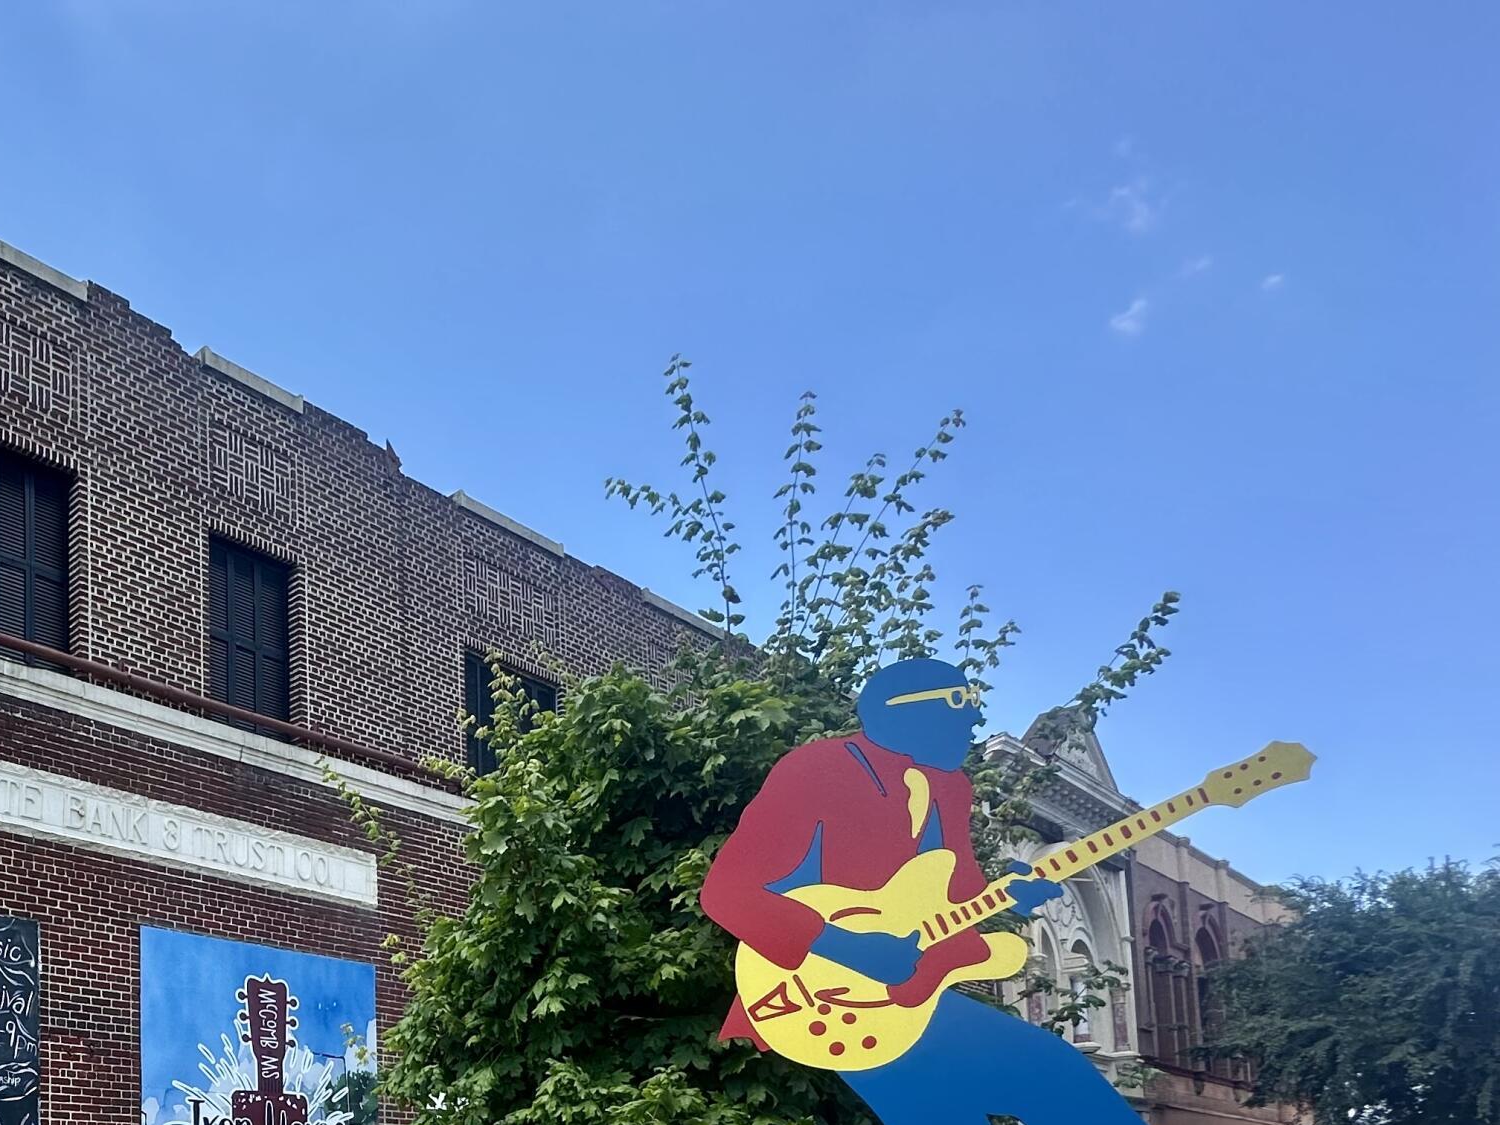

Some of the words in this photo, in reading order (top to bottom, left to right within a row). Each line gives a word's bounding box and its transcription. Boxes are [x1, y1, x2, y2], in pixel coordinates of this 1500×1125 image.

[63, 792, 148, 846] BANK
[162, 819, 181, 851] &
[193, 826, 285, 877] TRUST
[260, 1055, 280, 1080] MS
